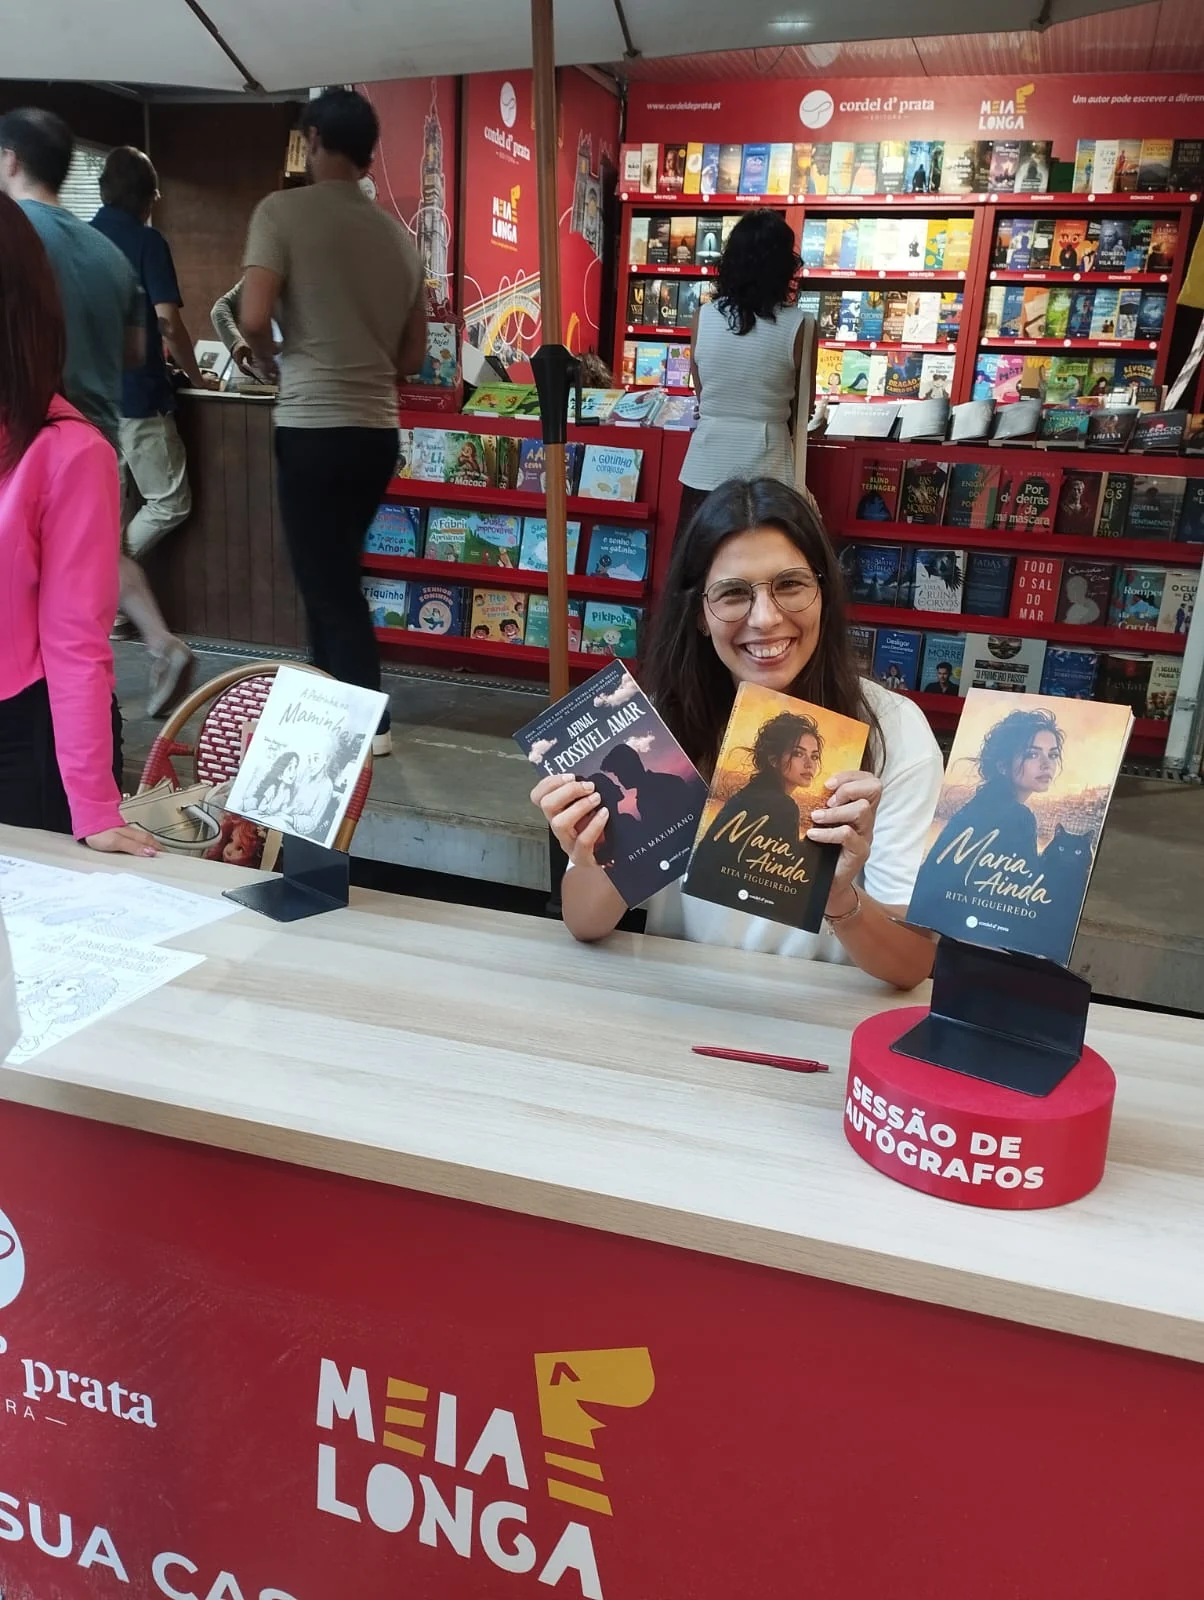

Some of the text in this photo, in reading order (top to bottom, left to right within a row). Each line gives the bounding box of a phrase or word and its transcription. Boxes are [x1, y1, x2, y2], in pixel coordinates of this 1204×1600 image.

[839, 98, 881, 112] cordel
[899, 99, 935, 113] prata
[1072, 95, 1087, 104] Um
[1088, 95, 1110, 104] autor
[1111, 94, 1132, 104] pode
[1133, 95, 1167, 103] escrever
[646, 102, 721, 111] www.cordeldeprata.pt
[980, 100, 1015, 115] MEIA
[978, 115, 1025, 130] LONGA
[484, 126, 506, 149] cordel
[513, 141, 531, 161] prata
[492, 196, 512, 222] MEIA
[492, 219, 518, 244] LONGA
[596, 464, 625, 475] corajosa
[455, 477, 487, 488] Macaco
[861, 483, 897, 493] TEENAGER
[869, 477, 889, 485] BLIND
[1025, 484, 1044, 495] Por
[1016, 494, 1049, 505] detrás
[1024, 505, 1037, 515] da
[1009, 513, 1050, 525] máscara
[377, 542, 404, 553] Amor
[609, 537, 630, 547] sonho
[609, 545, 637, 556] gatinho
[1024, 560, 1053, 574] TODO
[422, 586, 453, 596] SENHOR
[1019, 578, 1052, 591] O SAL
[1142, 581, 1150, 589] O
[1172, 584, 1179, 592] O
[363, 587, 404, 601] Tiquinho
[1026, 594, 1041, 606] DO
[592, 611, 632, 626] Pikipoka
[1019, 608, 1044, 621] MAR
[886, 637, 911, 647] Desligar
[981, 670, 1007, 682] PRIMEIRO
[278, 702, 352, 744] Maminha
[566, 712, 598, 740] AFINAL
[543, 701, 646, 776] É POSSÍVEL AMAR
[628, 813, 695, 862] RITA MAXIMIANO
[713, 810, 796, 863] Maria,
[936, 826, 1033, 887] Maria,
[746, 852, 810, 884] Ainda
[720, 866, 798, 896] RITA FIGUEIREDO
[973, 872, 1052, 907] Ainda
[945, 890, 1037, 920] RITA FIGUEIREDO
[852, 1076, 1022, 1160] SESSÃO DE
[845, 1096, 1044, 1190] AUTÓGRAFOS
[21, 1358, 157, 1428] prata
[316, 1357, 529, 1490] MEIA
[316, 1443, 604, 1600] LONGA
[0, 1491, 298, 1600] SUA CA
